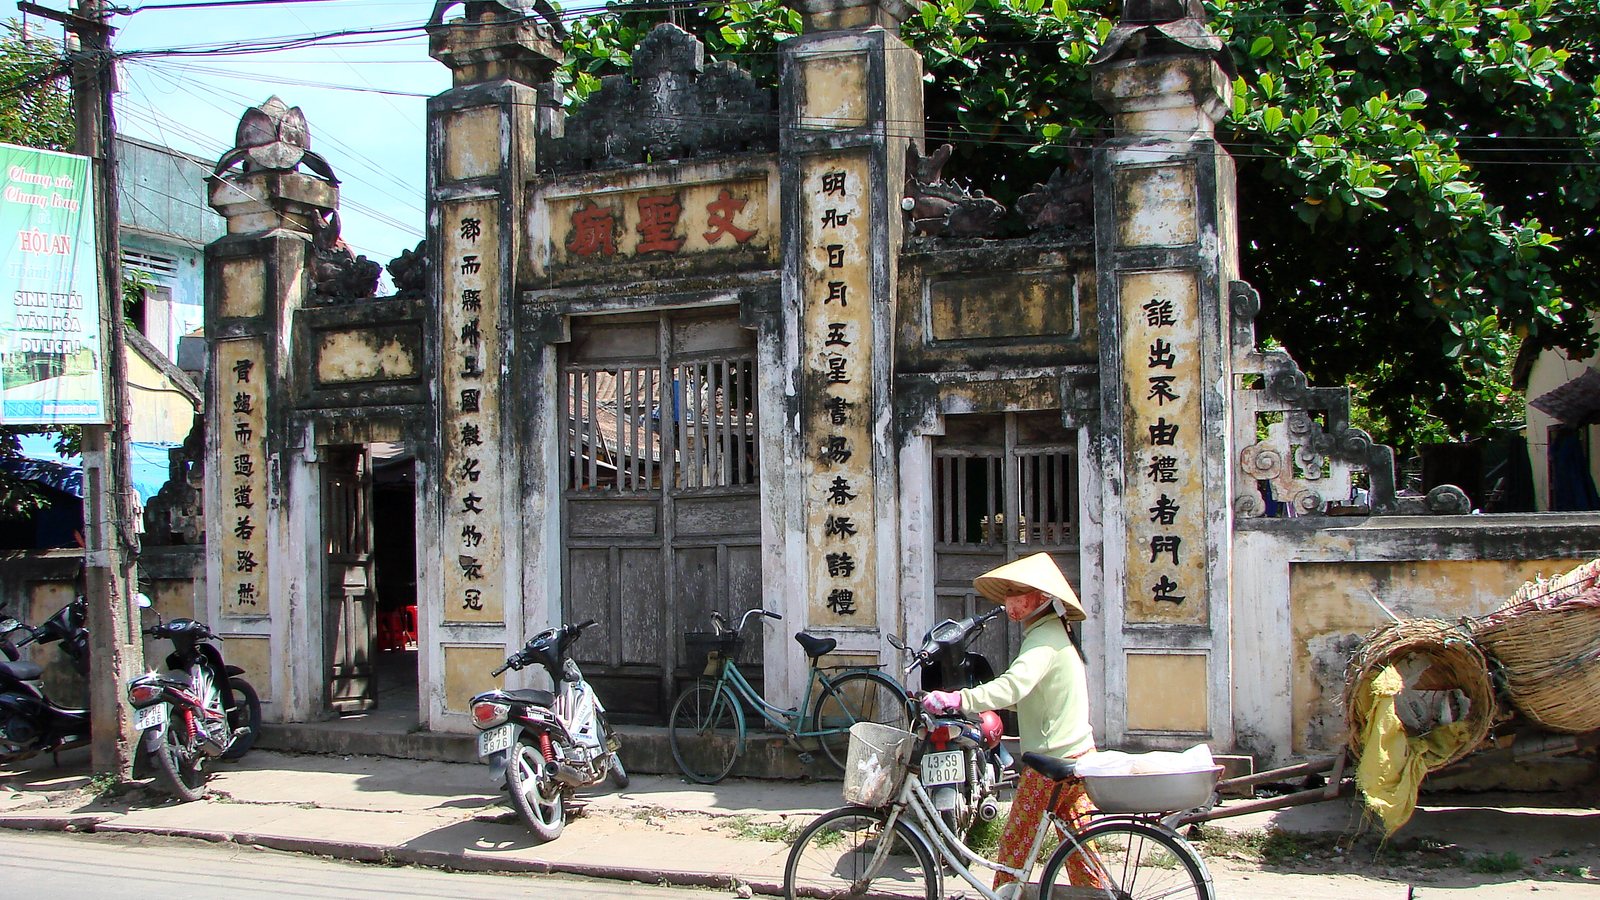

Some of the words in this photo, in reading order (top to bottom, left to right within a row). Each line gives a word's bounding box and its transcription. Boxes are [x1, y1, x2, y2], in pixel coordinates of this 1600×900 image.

[10, 166, 51, 188] Chung
[6, 186, 48, 209] Chung
[20, 228, 48, 256] HỘI
[48, 235, 71, 256] AN
[14, 290, 48, 308] SINH
[50, 290, 83, 310] THÁI
[16, 310, 48, 331] VĂN
[1142, 299, 1186, 605] 誰出不由禮者門也
[483, 738, 508, 754] 9876
[927, 754, 958, 769] 43-S9
[928, 768, 959, 783] 4802
